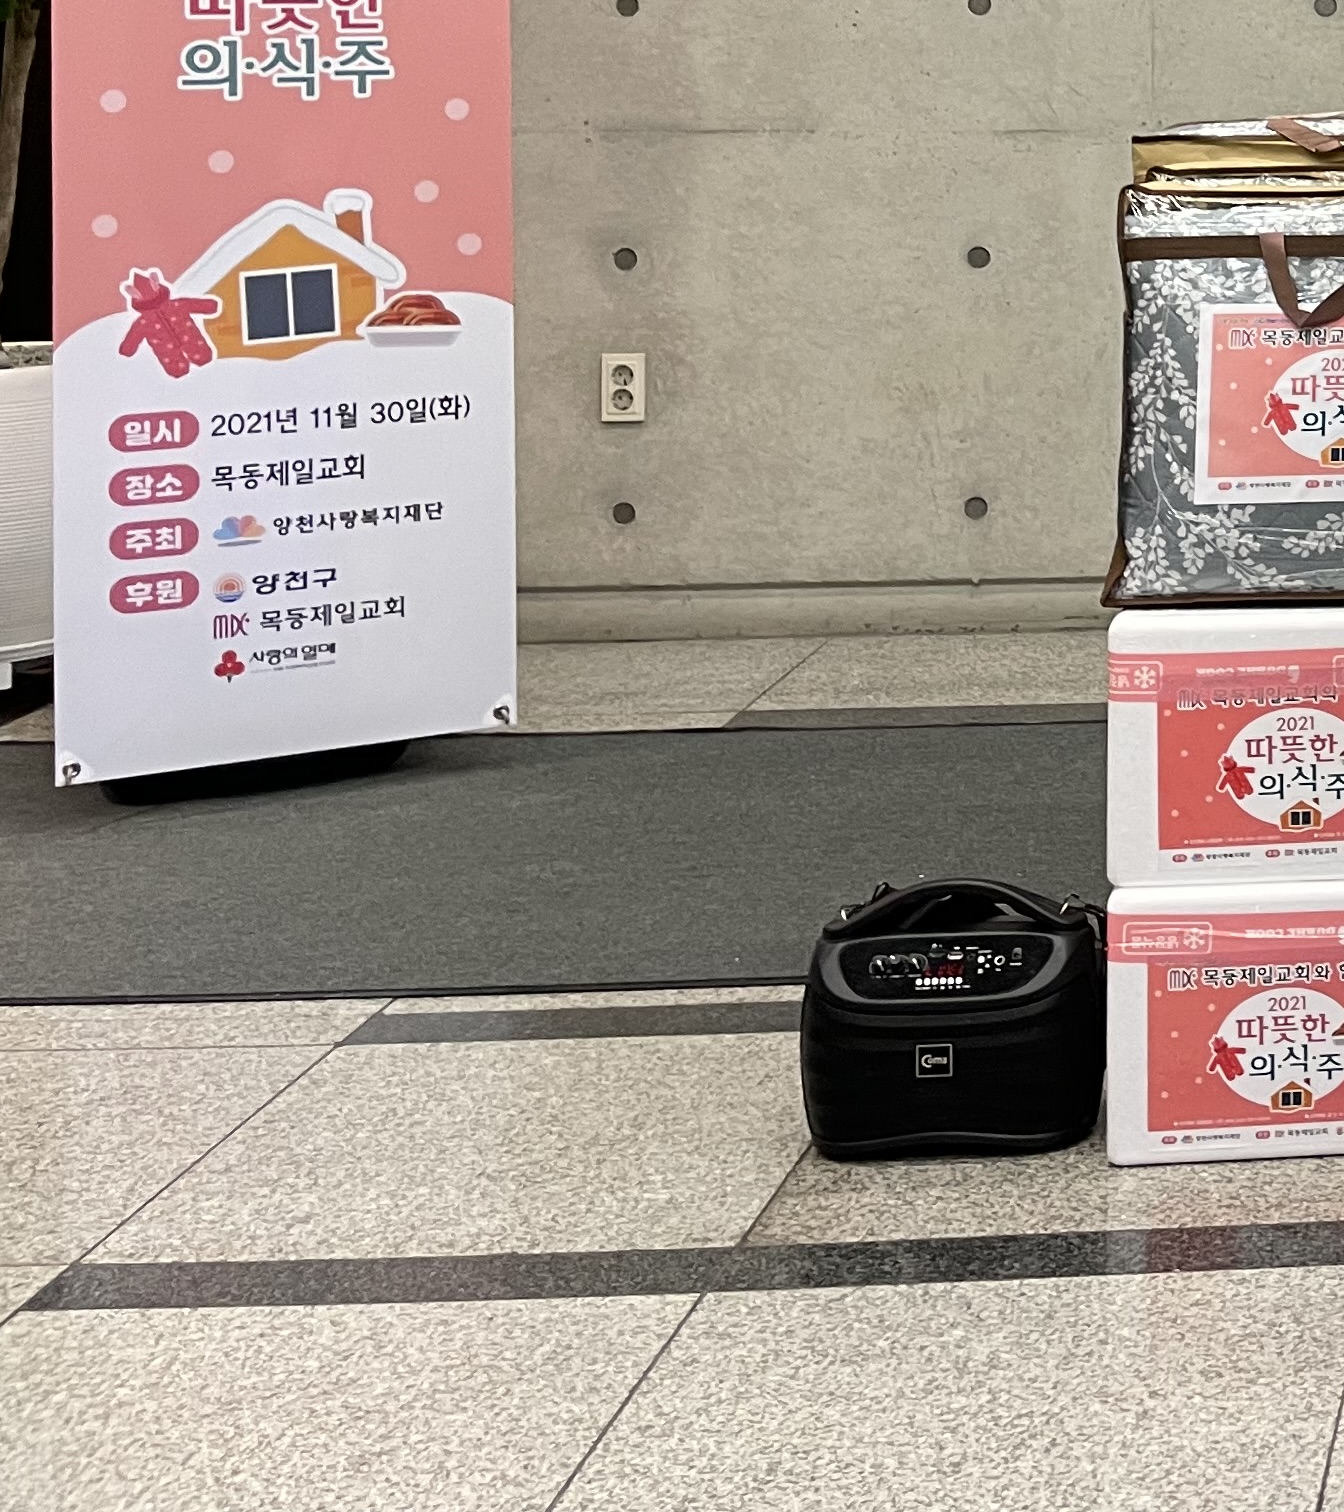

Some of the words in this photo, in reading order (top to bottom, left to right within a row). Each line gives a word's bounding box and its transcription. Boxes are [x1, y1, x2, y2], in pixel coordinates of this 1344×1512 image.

[178, 37, 394, 100] 의·식·주
[123, 420, 181, 446] 일시
[210, 408, 298, 438] 2021년
[310, 403, 358, 430] 11월
[370, 394, 471, 426] 30일(화)
[125, 473, 183, 500] 장소
[210, 453, 367, 492] 목동제일교회
[125, 526, 183, 553] 주최
[272, 501, 444, 538] 양천사랑복지재단
[125, 579, 183, 607] 후원
[252, 568, 338, 595] 양천구
[259, 596, 406, 632] 목동제일교회
[1276, 716, 1316, 732] 2021
[1245, 734, 1339, 764] 따뜻한
[1203, 964, 1331, 987] 목동제일교회와
[1267, 996, 1307, 1013] 2021
[1236, 1013, 1331, 1045] 따뜻한
[1249, 1044, 1344, 1080] 의·식·주
